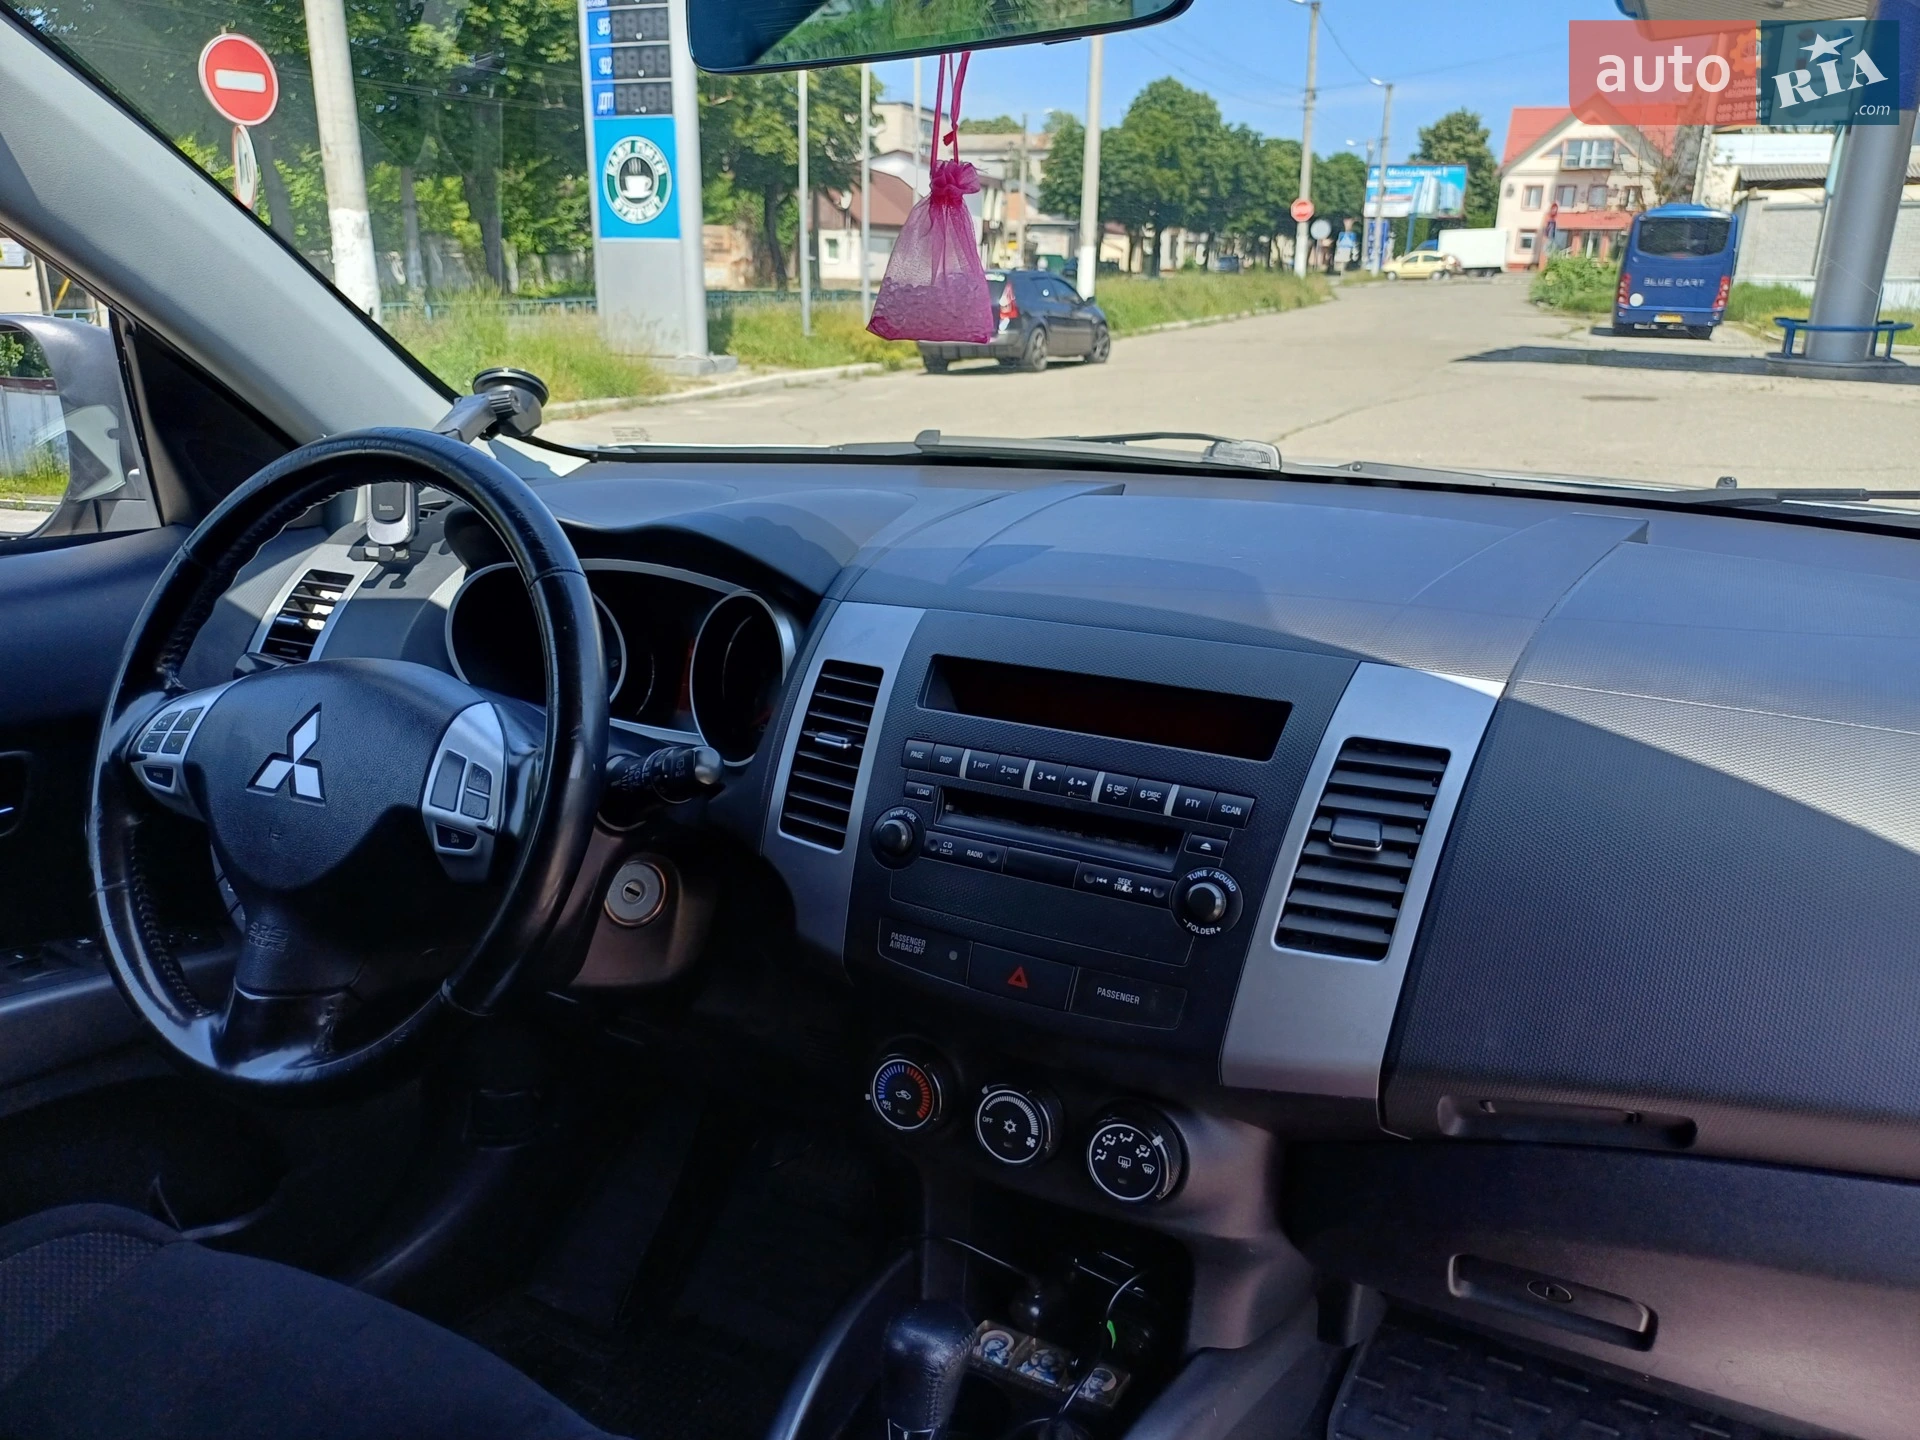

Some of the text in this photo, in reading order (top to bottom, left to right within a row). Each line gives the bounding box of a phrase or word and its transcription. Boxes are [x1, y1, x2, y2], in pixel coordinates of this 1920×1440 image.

[597, 17, 611, 36] 95
[598, 56, 613, 75] 92
[1643, 277, 1672, 287] BLUE
[910, 751, 924, 759] PAGE
[939, 755, 952, 764] DISP
[1000, 765, 1019, 774] 2 RDM
[1037, 772, 1043, 780] 3
[1068, 777, 1074, 785] 4
[917, 788, 929, 796] LOAD
[1106, 784, 1128, 793] 5 DISC
[1139, 789, 1161, 798] 6 DISC
[1185, 798, 1200, 808] PTY
[1220, 804, 1241, 816] SCAN
[943, 841, 953, 849] CD
[966, 849, 983, 859] RADIO
[1117, 877, 1132, 886] SEEK
[1113, 884, 1133, 893] TRACK
[891, 932, 926, 947] PASSENGER
[913, 946, 925, 955] OFF
[1096, 987, 1140, 1005] PASSENGER
